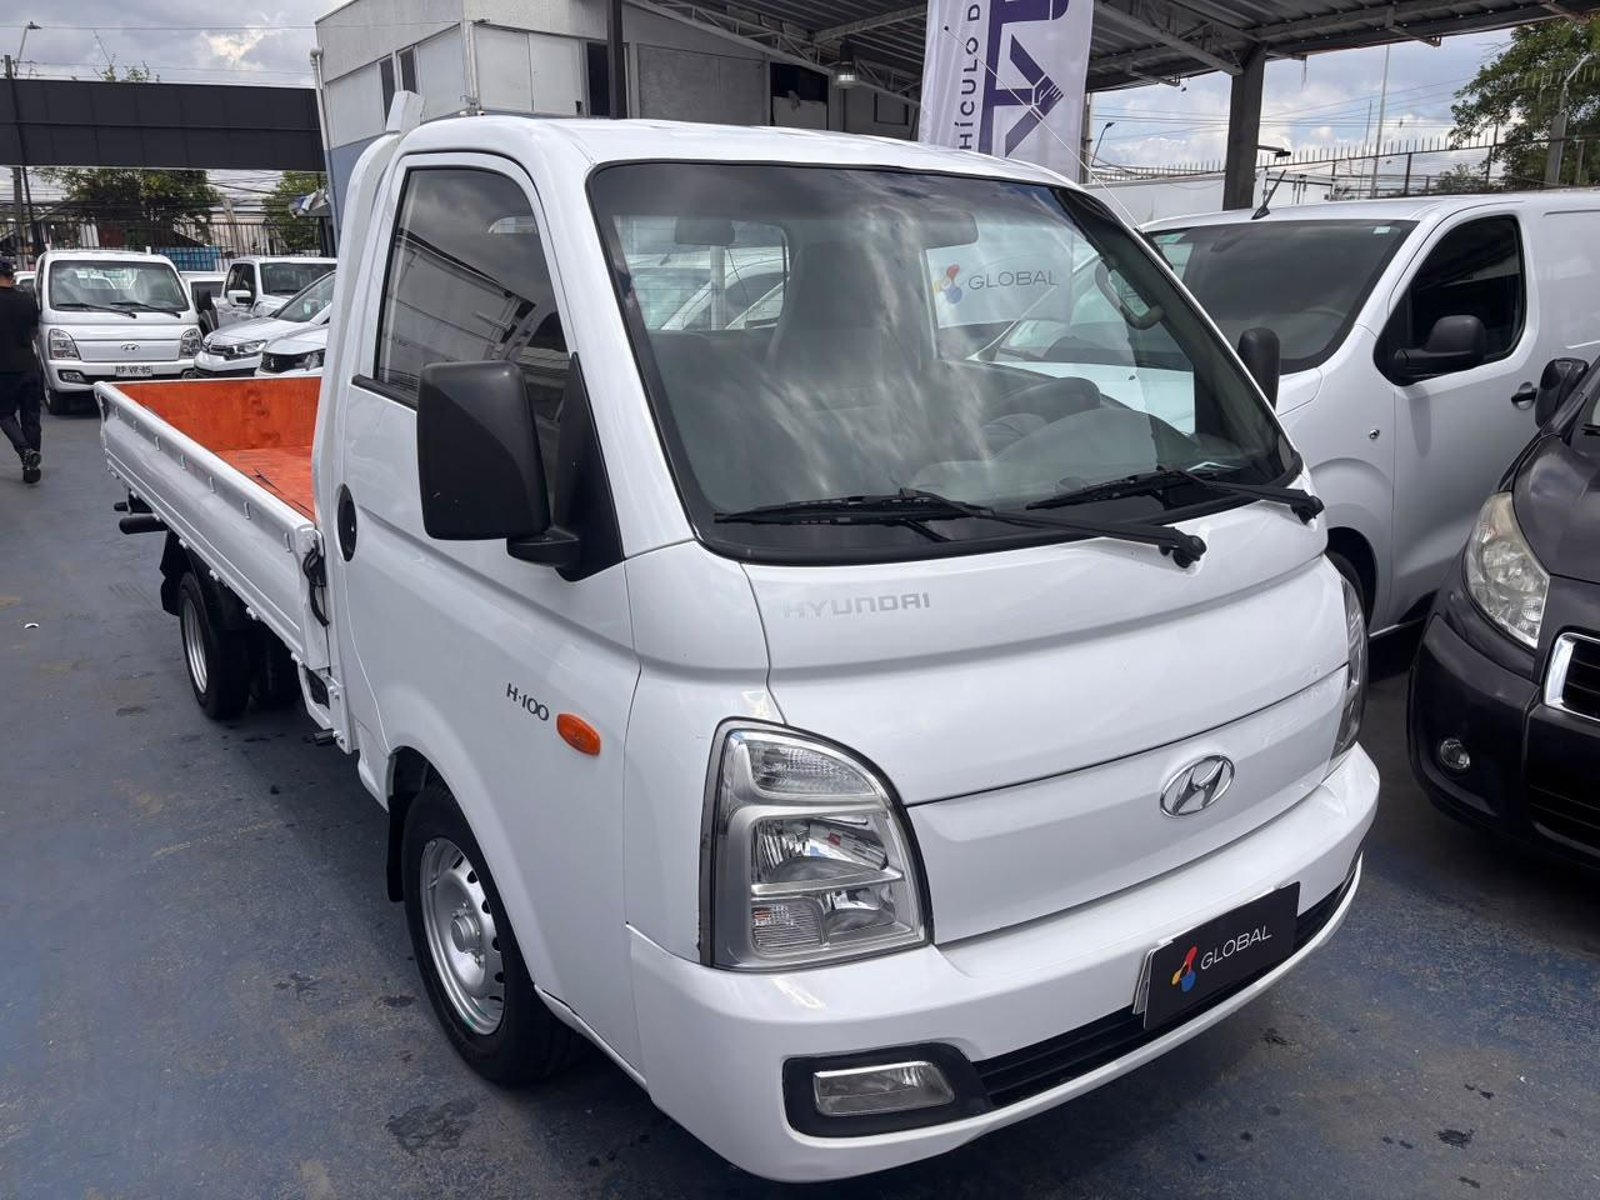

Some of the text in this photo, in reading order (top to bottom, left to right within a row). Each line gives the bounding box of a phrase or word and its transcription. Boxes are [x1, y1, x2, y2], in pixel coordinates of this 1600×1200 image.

[968, 270, 1059, 290] GLOBAL
[783, 592, 931, 619] HYUNDAI
[1200, 924, 1272, 970] GLOBAL
